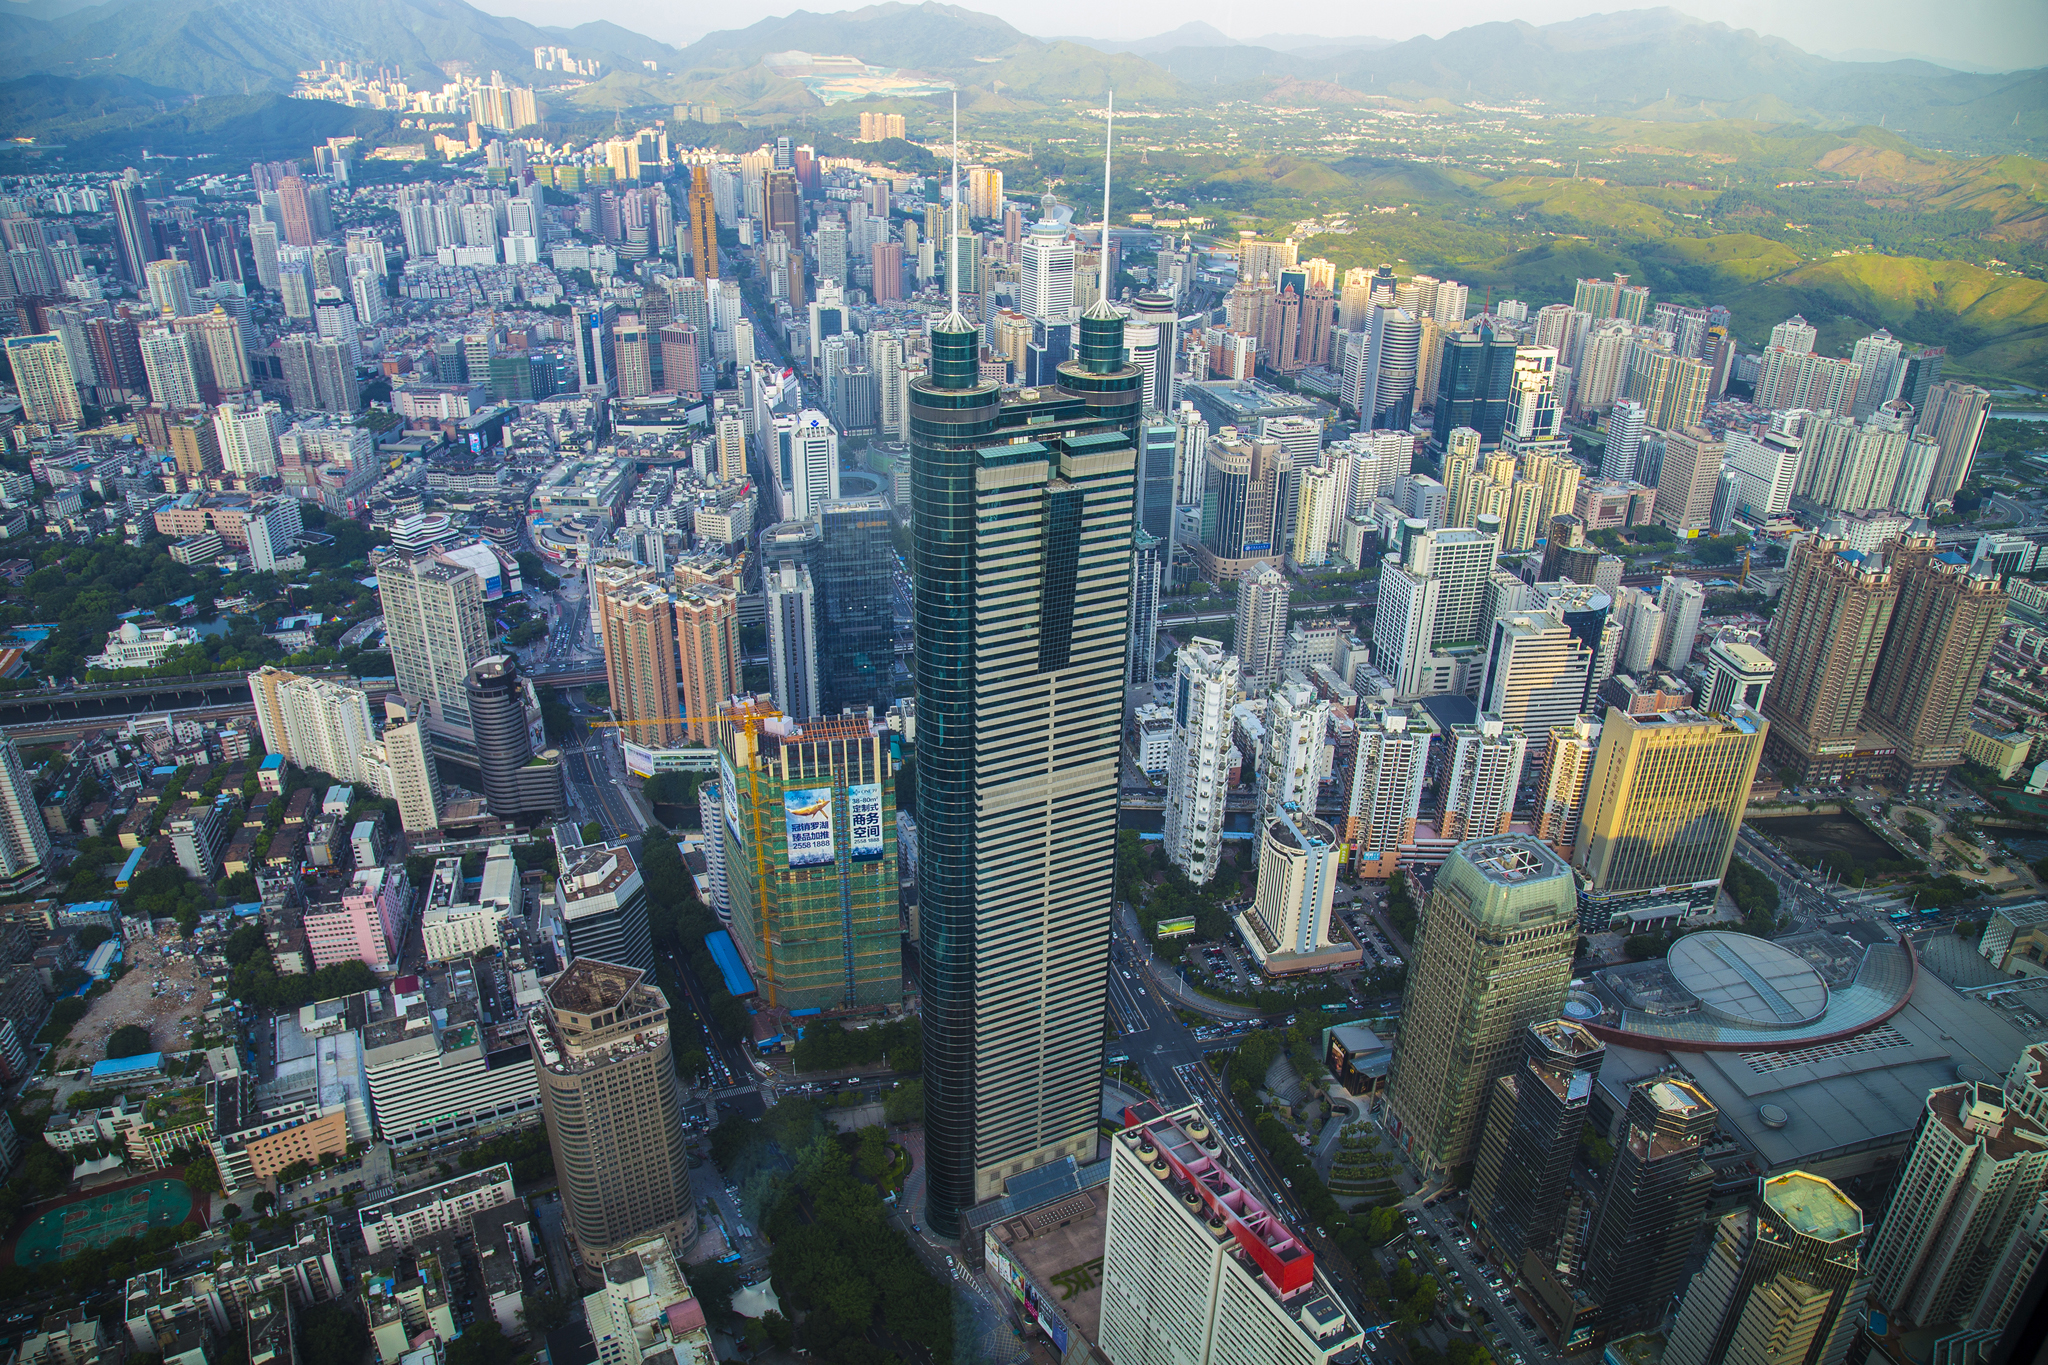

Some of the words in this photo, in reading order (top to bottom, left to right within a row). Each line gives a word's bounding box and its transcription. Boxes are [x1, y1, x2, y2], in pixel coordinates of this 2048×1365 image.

[852, 803, 879, 813] 定制式
[852, 812, 880, 826] 商务
[791, 821, 829, 832] 冠销罗湖
[853, 825, 880, 839] 空间
[792, 831, 830, 842] 臻品加推
[793, 841, 811, 850] 2558
[812, 839, 830, 848] 1888
